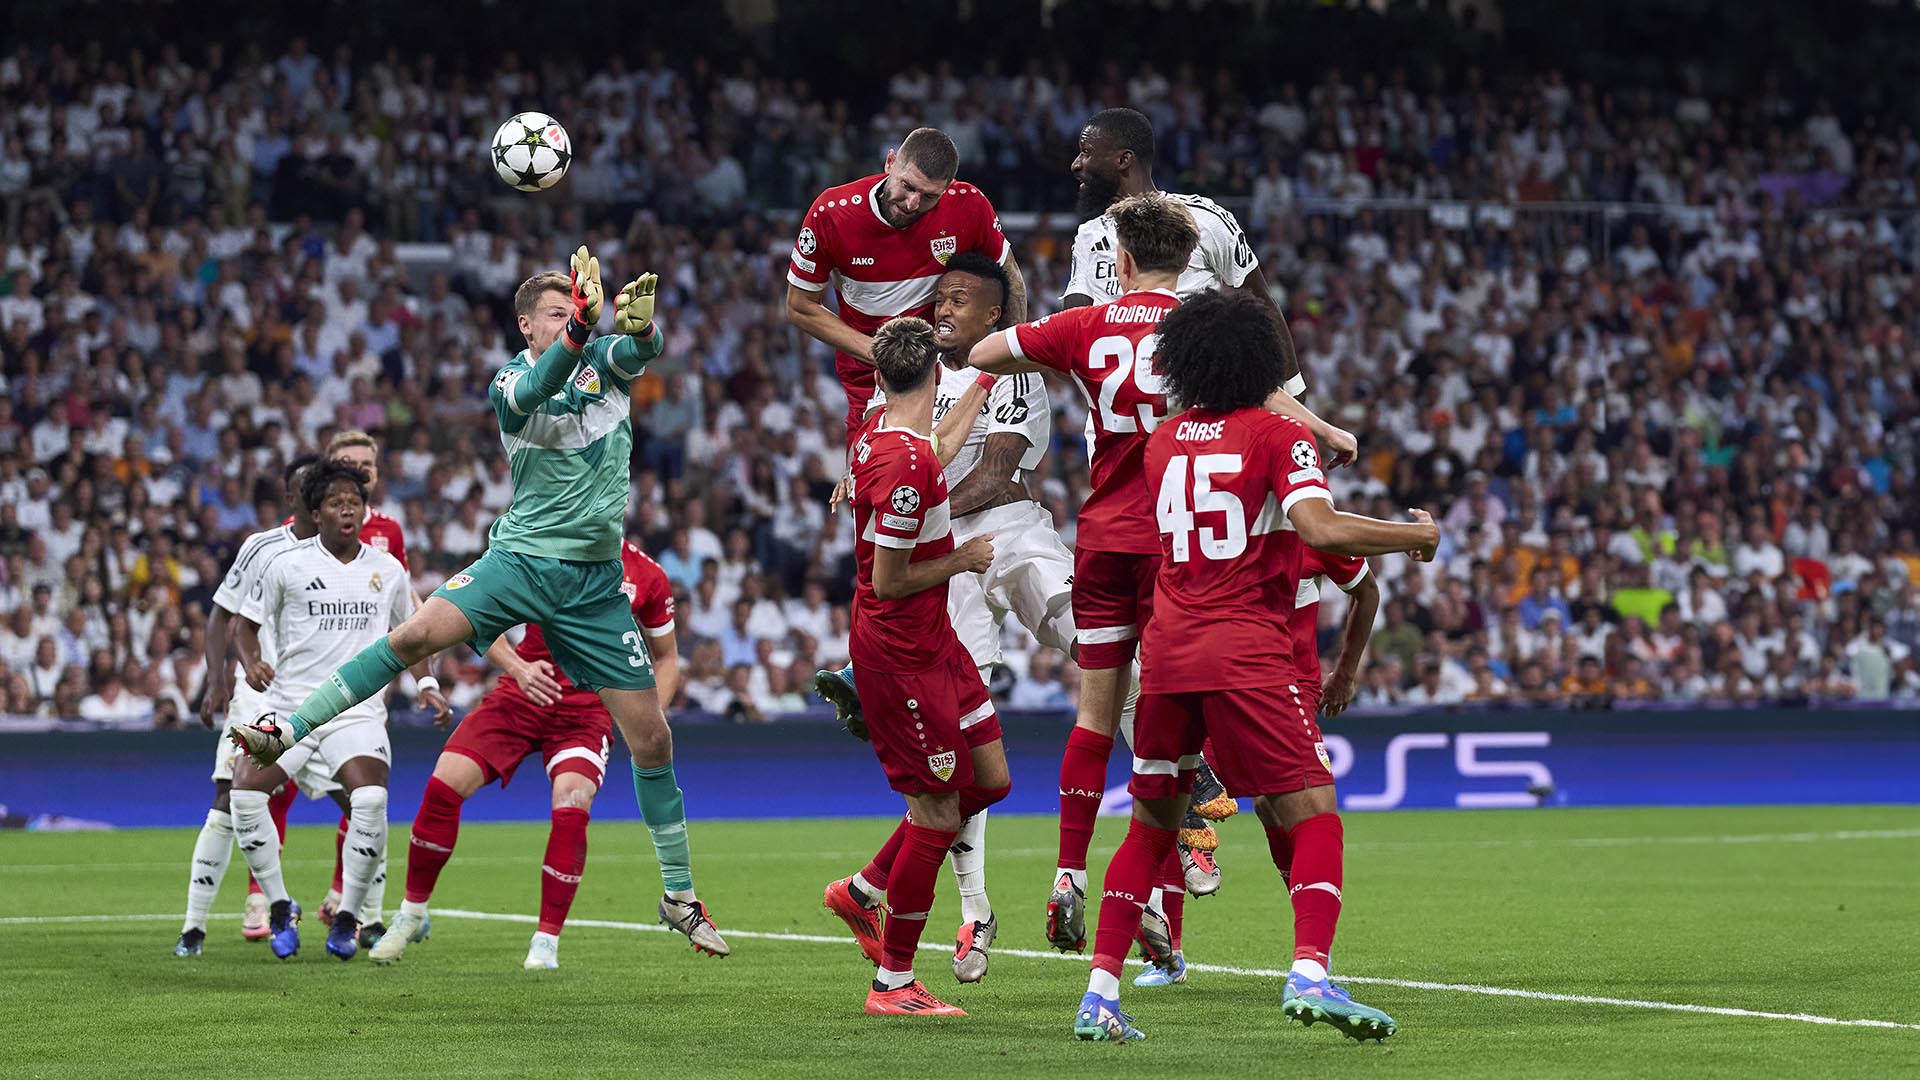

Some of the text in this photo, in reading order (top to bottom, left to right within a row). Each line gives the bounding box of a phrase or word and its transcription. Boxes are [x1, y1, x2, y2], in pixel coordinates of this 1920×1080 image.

[851, 257, 875, 266] JAKO
[996, 402, 1029, 425] hp
[1175, 420, 1226, 442] CHASE
[1156, 453, 1248, 563] 45
[308, 599, 378, 616] Emirates
[318, 617, 369, 631] FLY BETTER
[1067, 787, 1103, 799] JAKO
